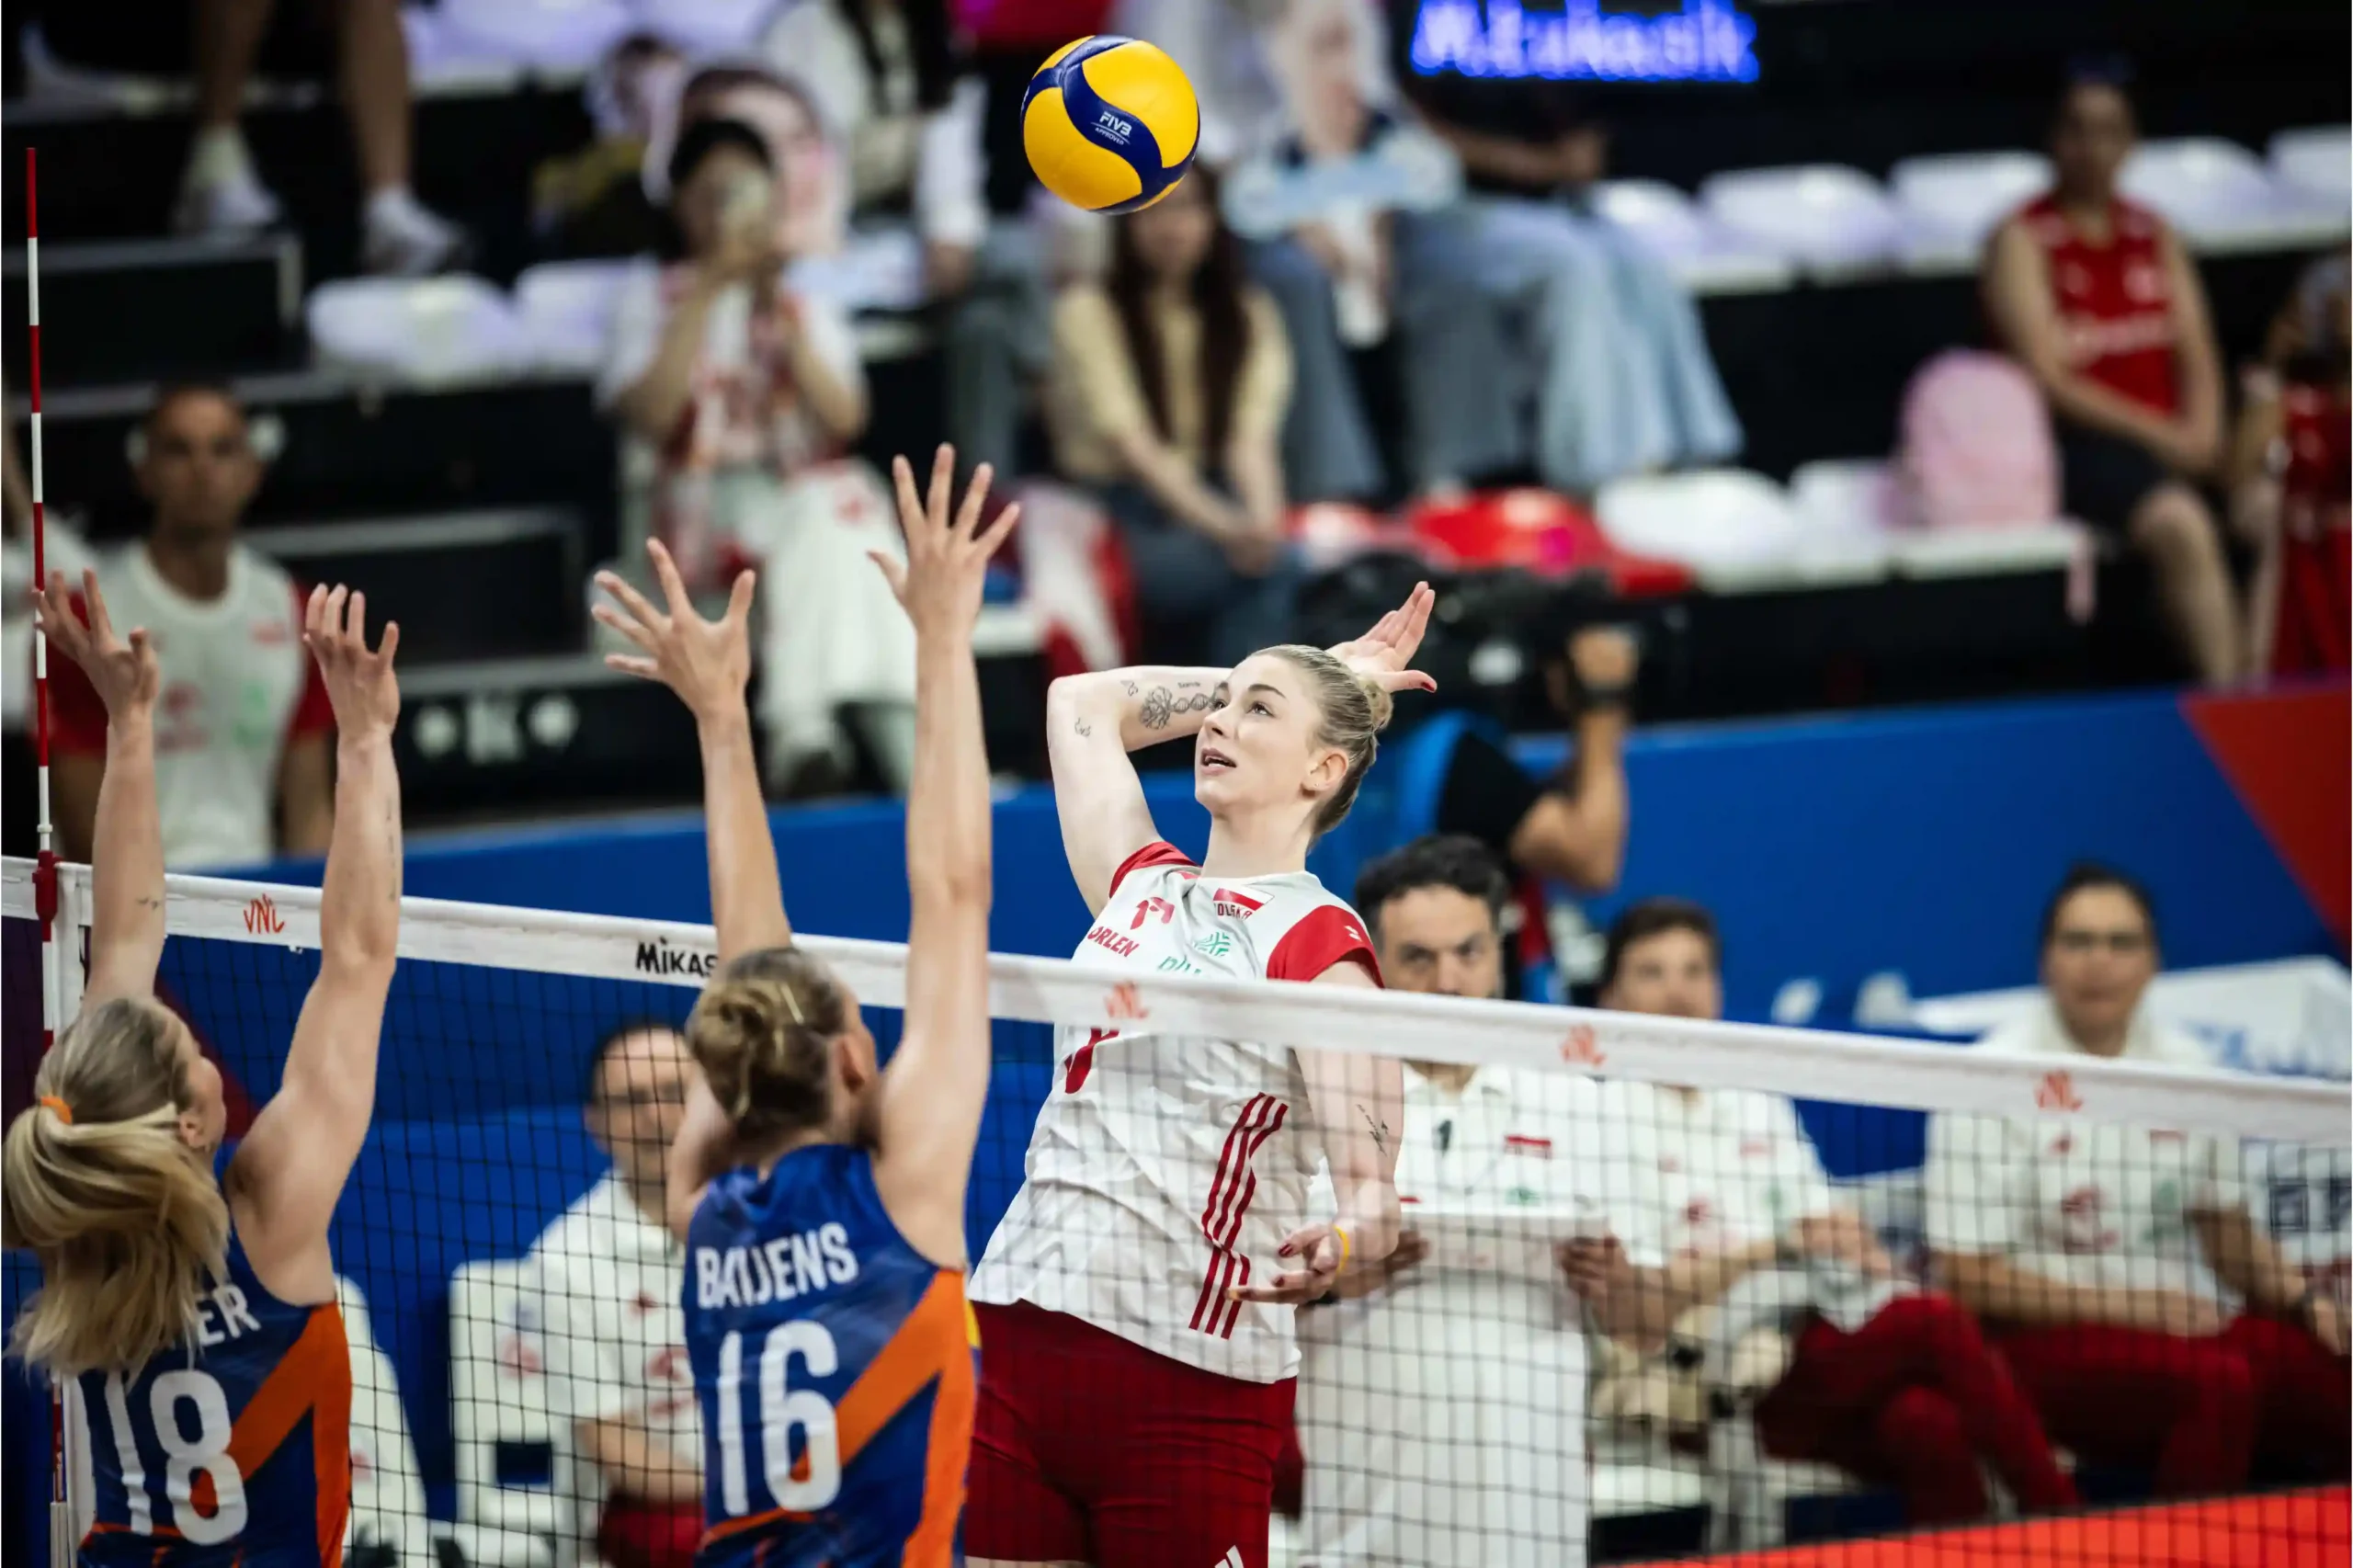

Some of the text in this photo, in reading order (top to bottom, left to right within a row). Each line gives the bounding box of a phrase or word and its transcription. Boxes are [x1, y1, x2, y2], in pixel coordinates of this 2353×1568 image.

[1095, 127, 1125, 145] APPROVED
[1213, 903, 1253, 922] OLSKA
[1087, 926, 1140, 958] ORLEN
[717, 1320, 842, 1517] 16
[104, 1369, 248, 1546] 18
